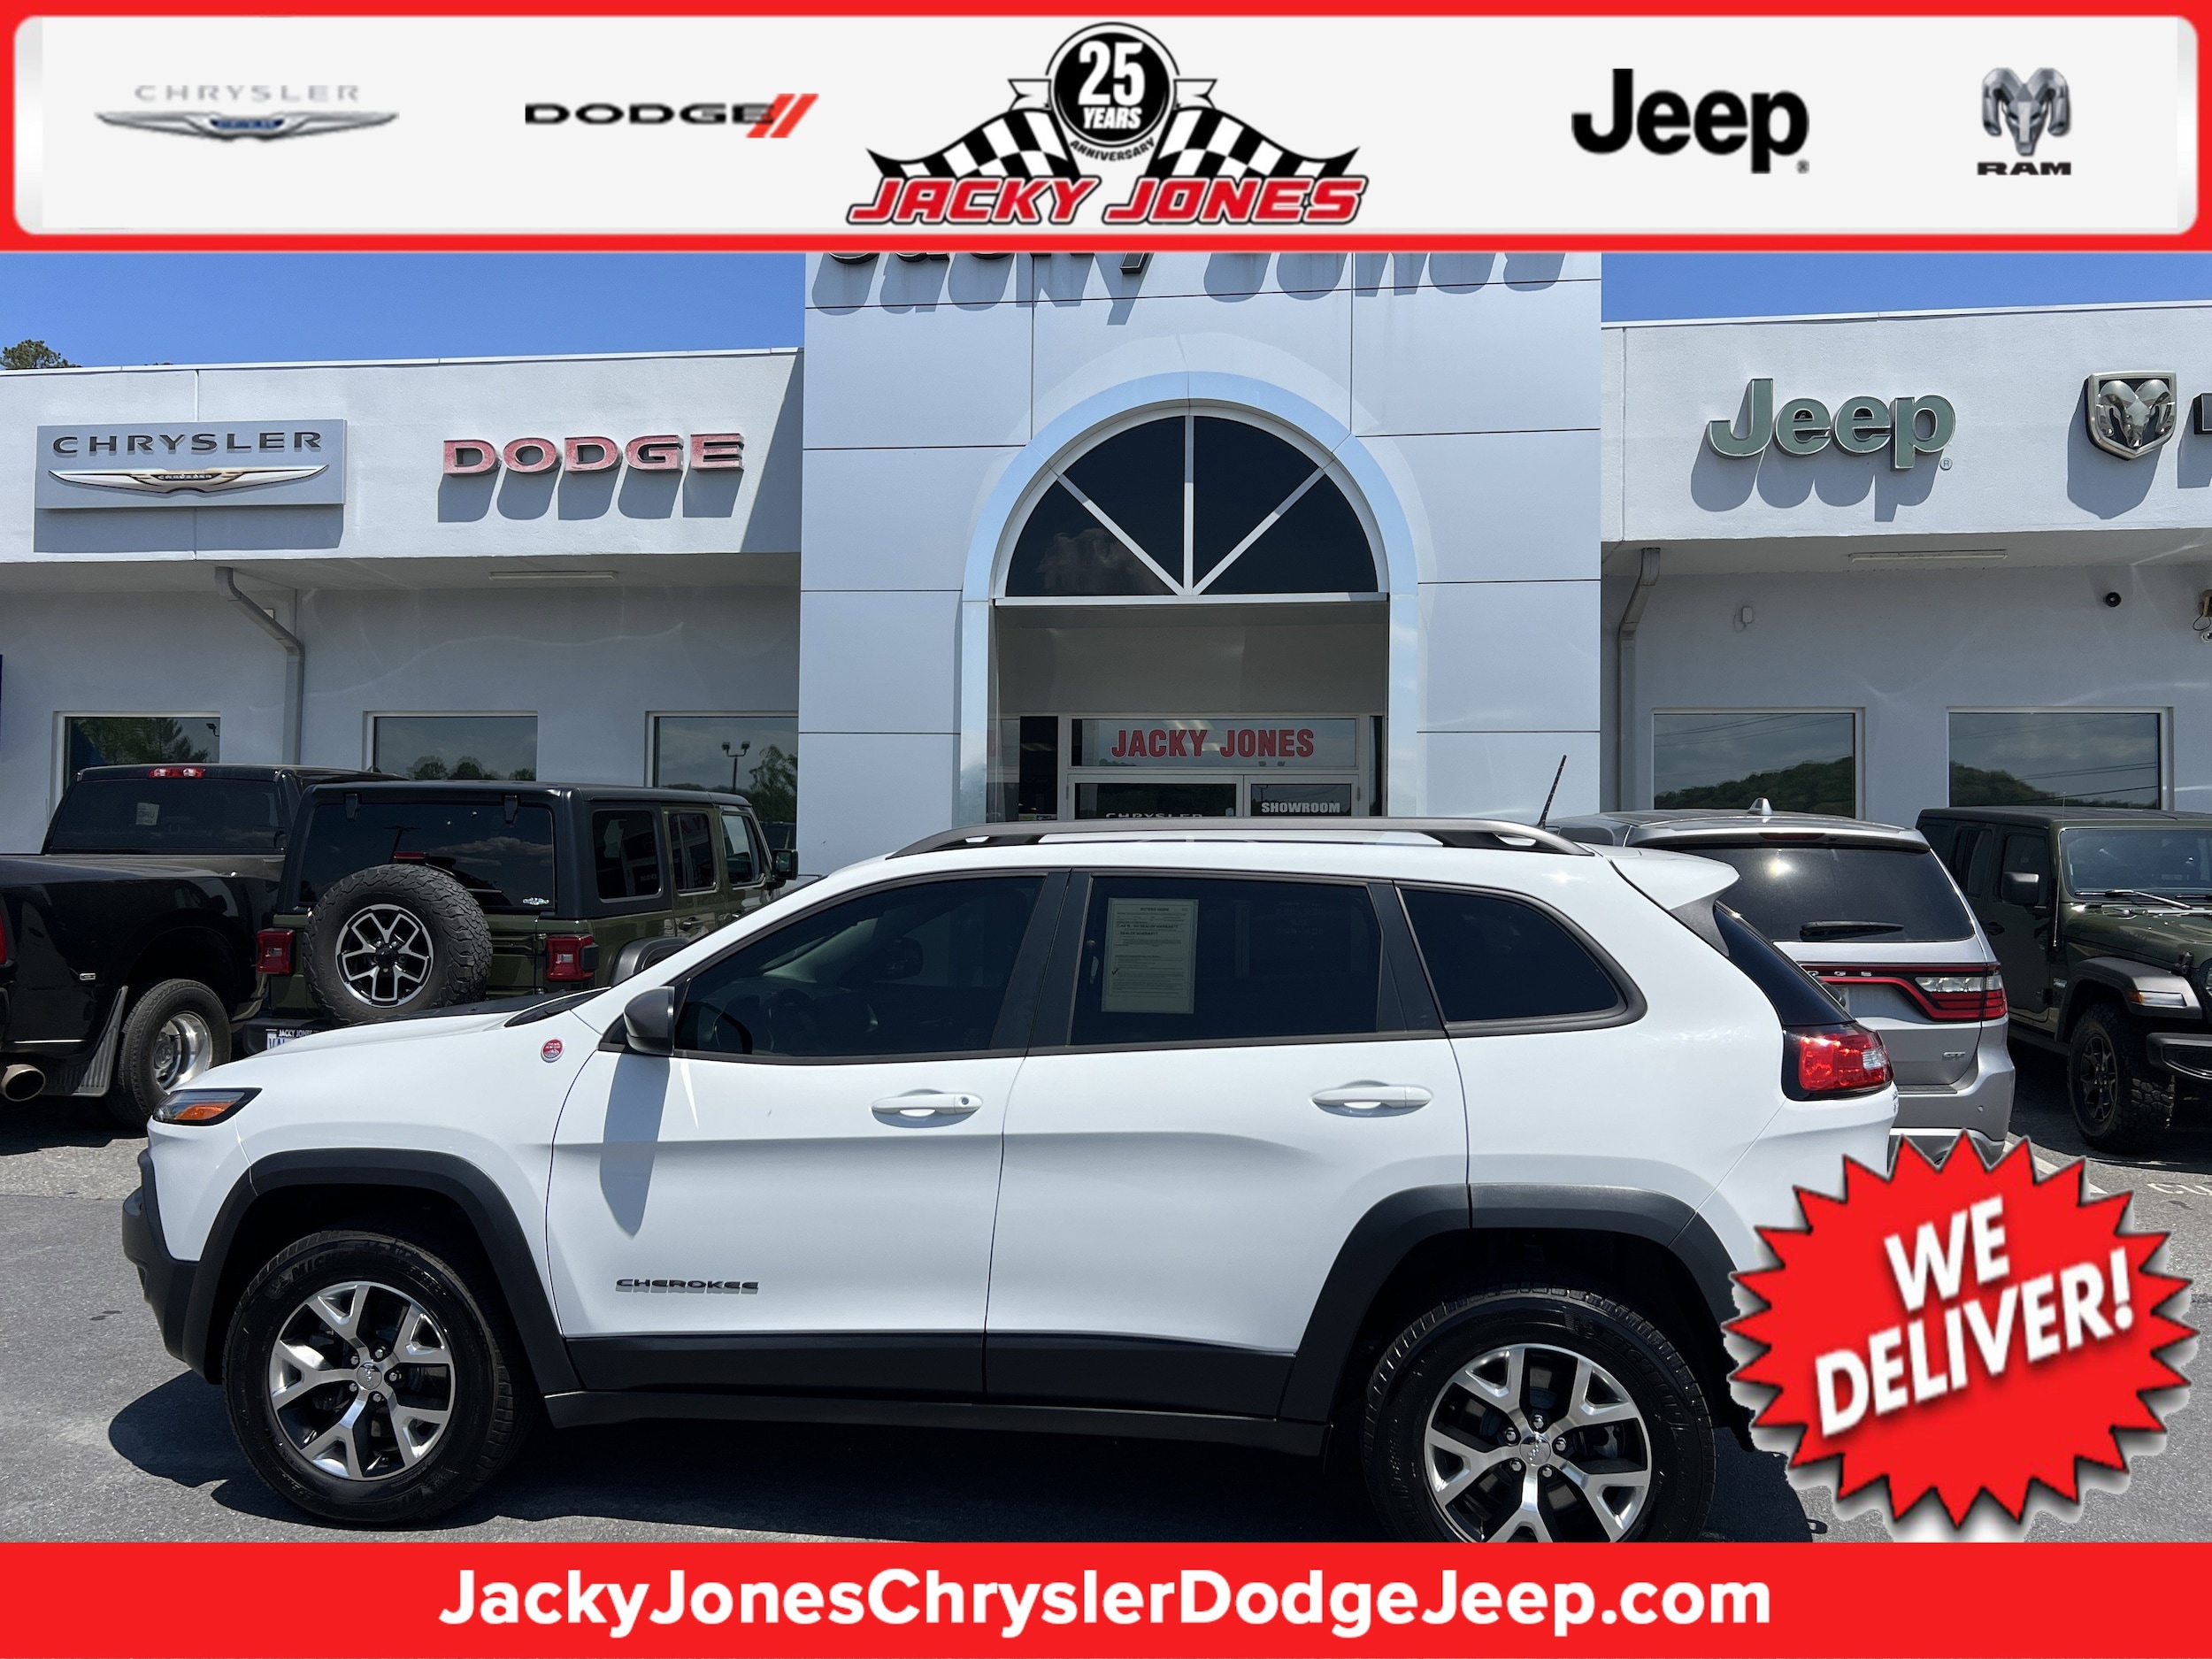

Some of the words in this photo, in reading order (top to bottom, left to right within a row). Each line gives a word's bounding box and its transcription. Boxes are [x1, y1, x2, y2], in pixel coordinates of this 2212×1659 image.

[1707, 378, 1956, 471] Jeep
[51, 430, 323, 455] CHRYSLER
[443, 434, 744, 475] DODGE
[1111, 729, 1208, 757] JACKY
[1219, 729, 1314, 757] JONES
[1261, 803, 1340, 813] SHOWROOM
[279, 1028, 295, 1037] JACKY
[616, 1279, 758, 1289] CHEROKEE
